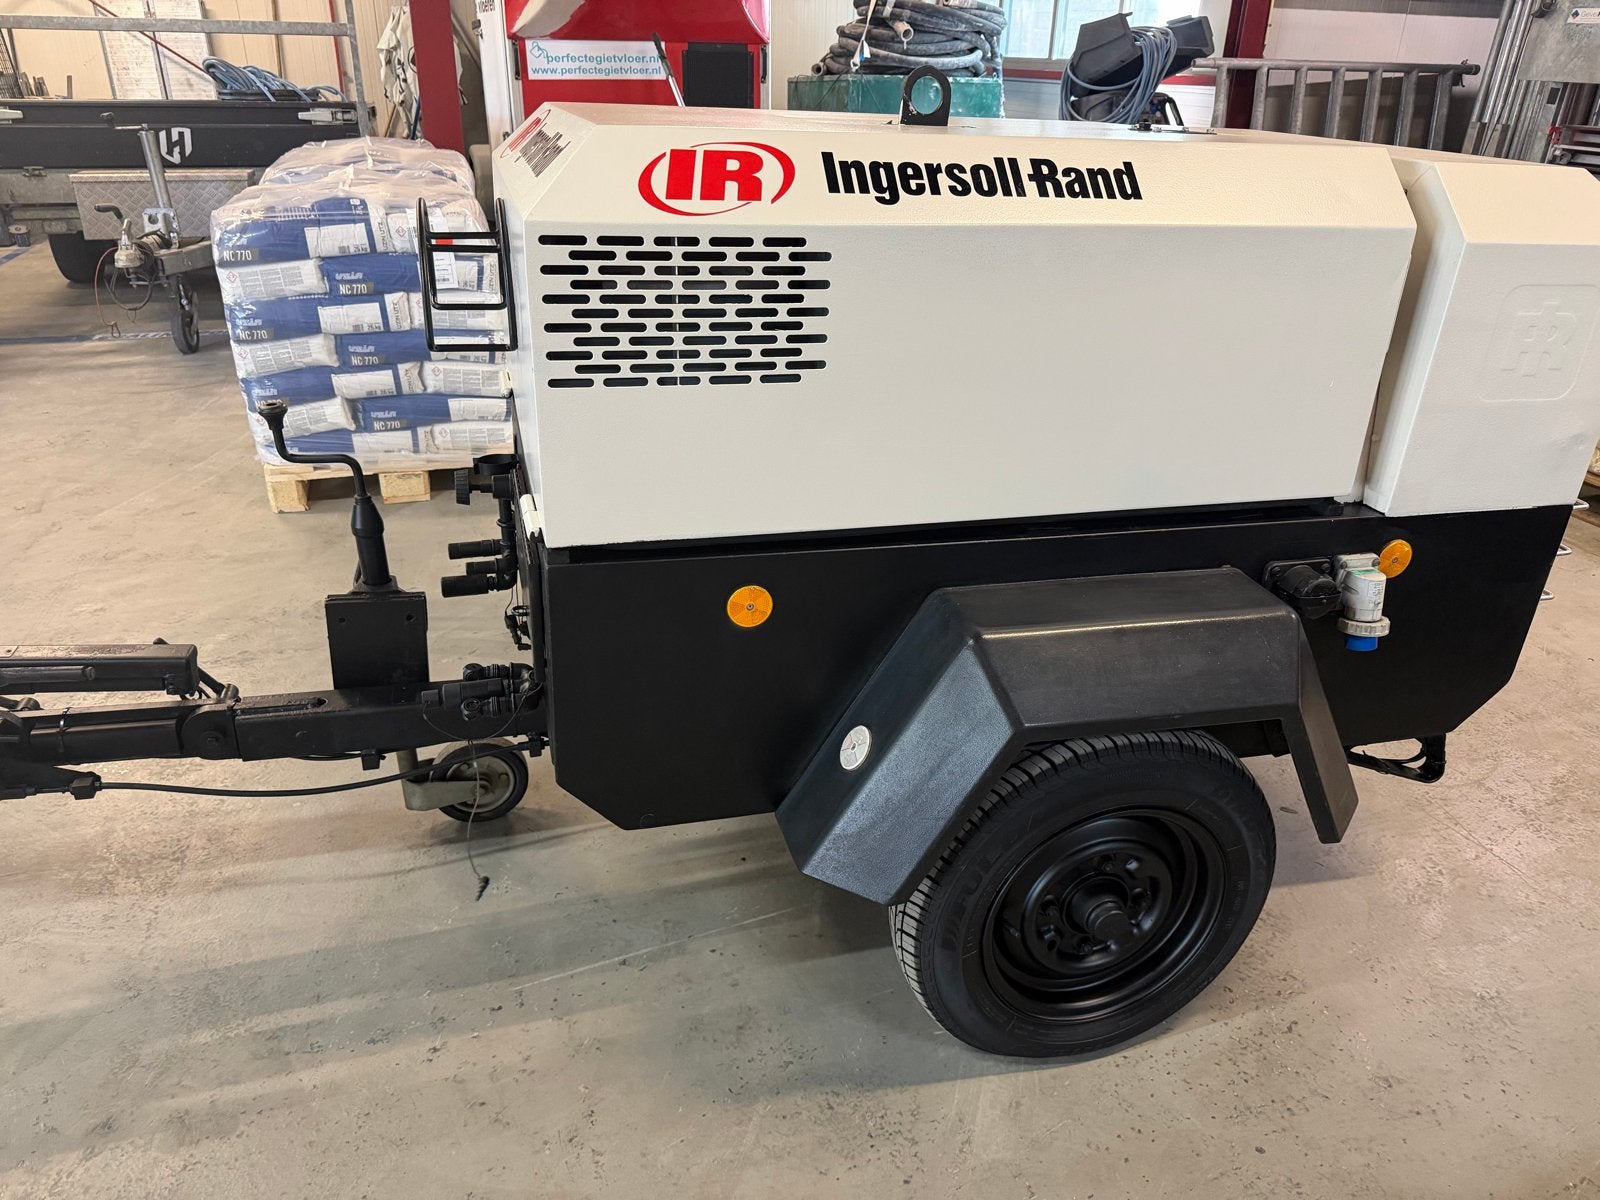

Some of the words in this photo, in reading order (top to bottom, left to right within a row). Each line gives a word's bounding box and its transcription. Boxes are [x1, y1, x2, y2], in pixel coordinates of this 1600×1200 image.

[531, 66, 661, 76] www.perfectegietvloer.nl
[665, 149, 763, 201] IR
[236, 249, 252, 261] 770
[339, 284, 352, 295] NC
[353, 283, 368, 294] 770
[252, 329, 268, 340] 770
[351, 355, 363, 366] NC
[364, 356, 378, 366] 770
[373, 421, 385, 431] NC
[386, 420, 400, 430] 770
